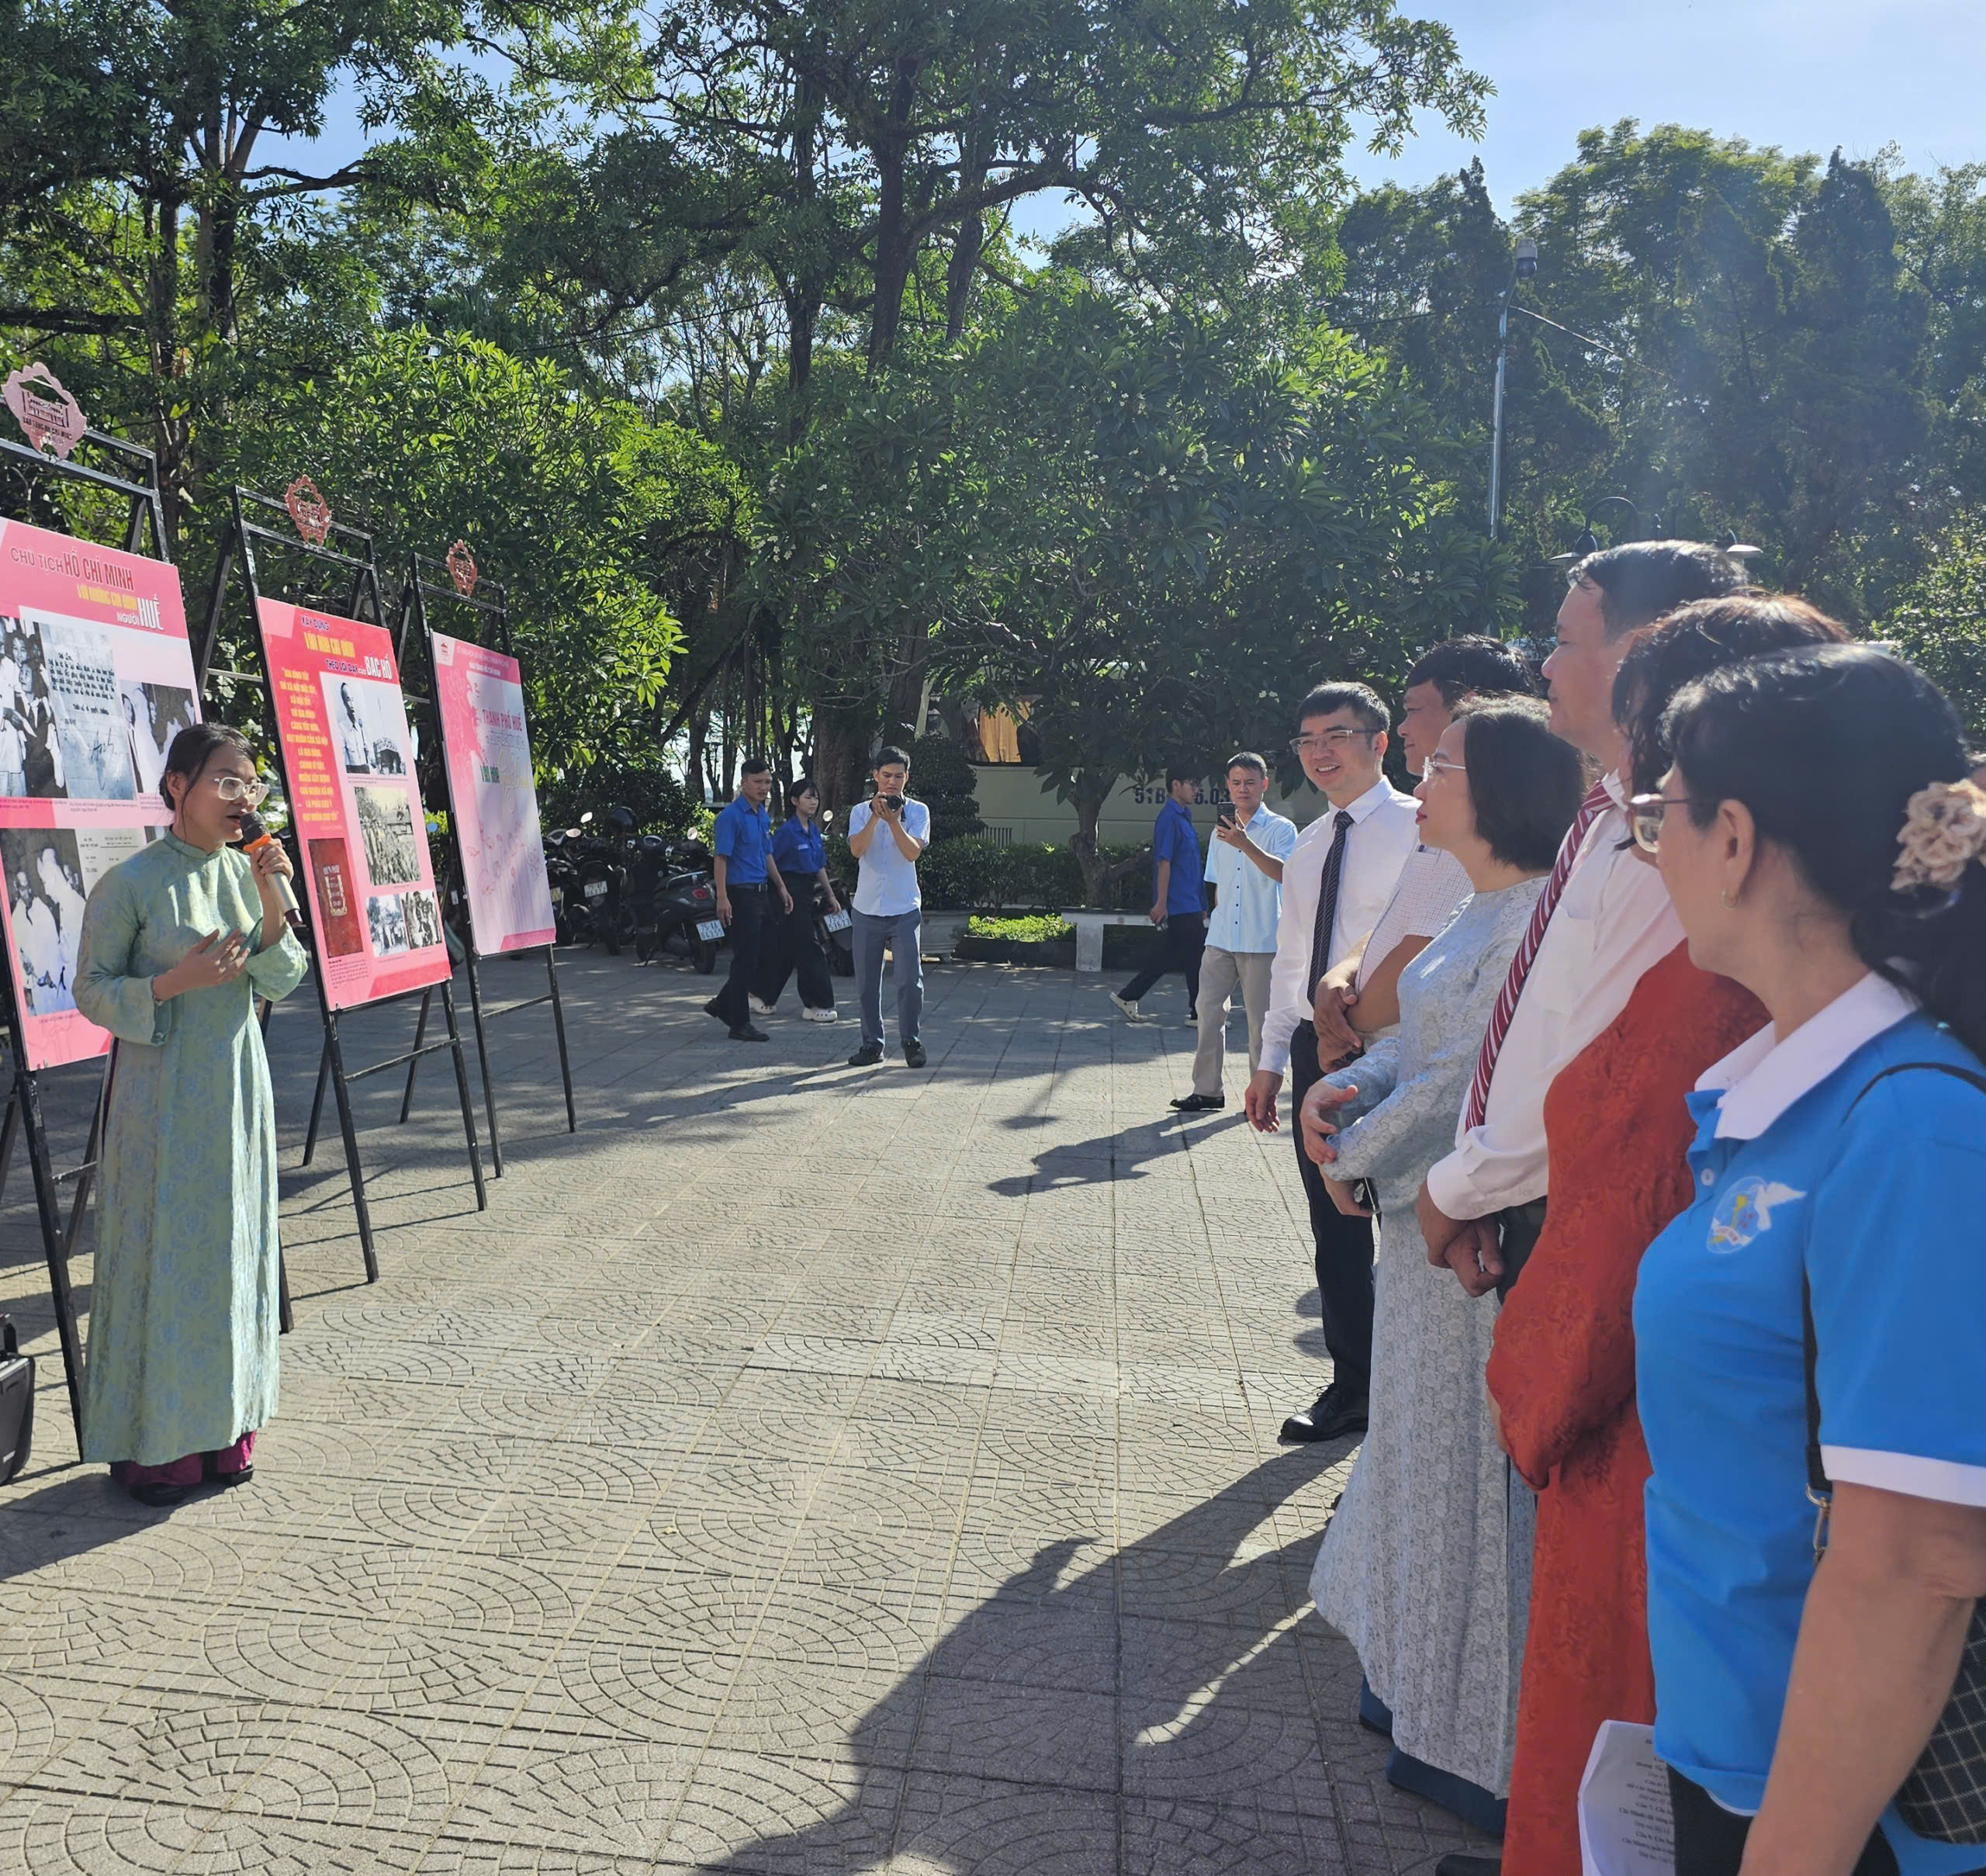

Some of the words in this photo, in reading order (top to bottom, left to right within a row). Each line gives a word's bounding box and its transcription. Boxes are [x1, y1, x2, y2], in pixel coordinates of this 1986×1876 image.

[38, 554, 64, 576] TỊCH
[64, 546, 80, 577] HỒ
[83, 556, 102, 583] CHÍ
[104, 563, 134, 590] MINH
[137, 593, 164, 631] HUẾ
[364, 652, 381, 678] BÁC
